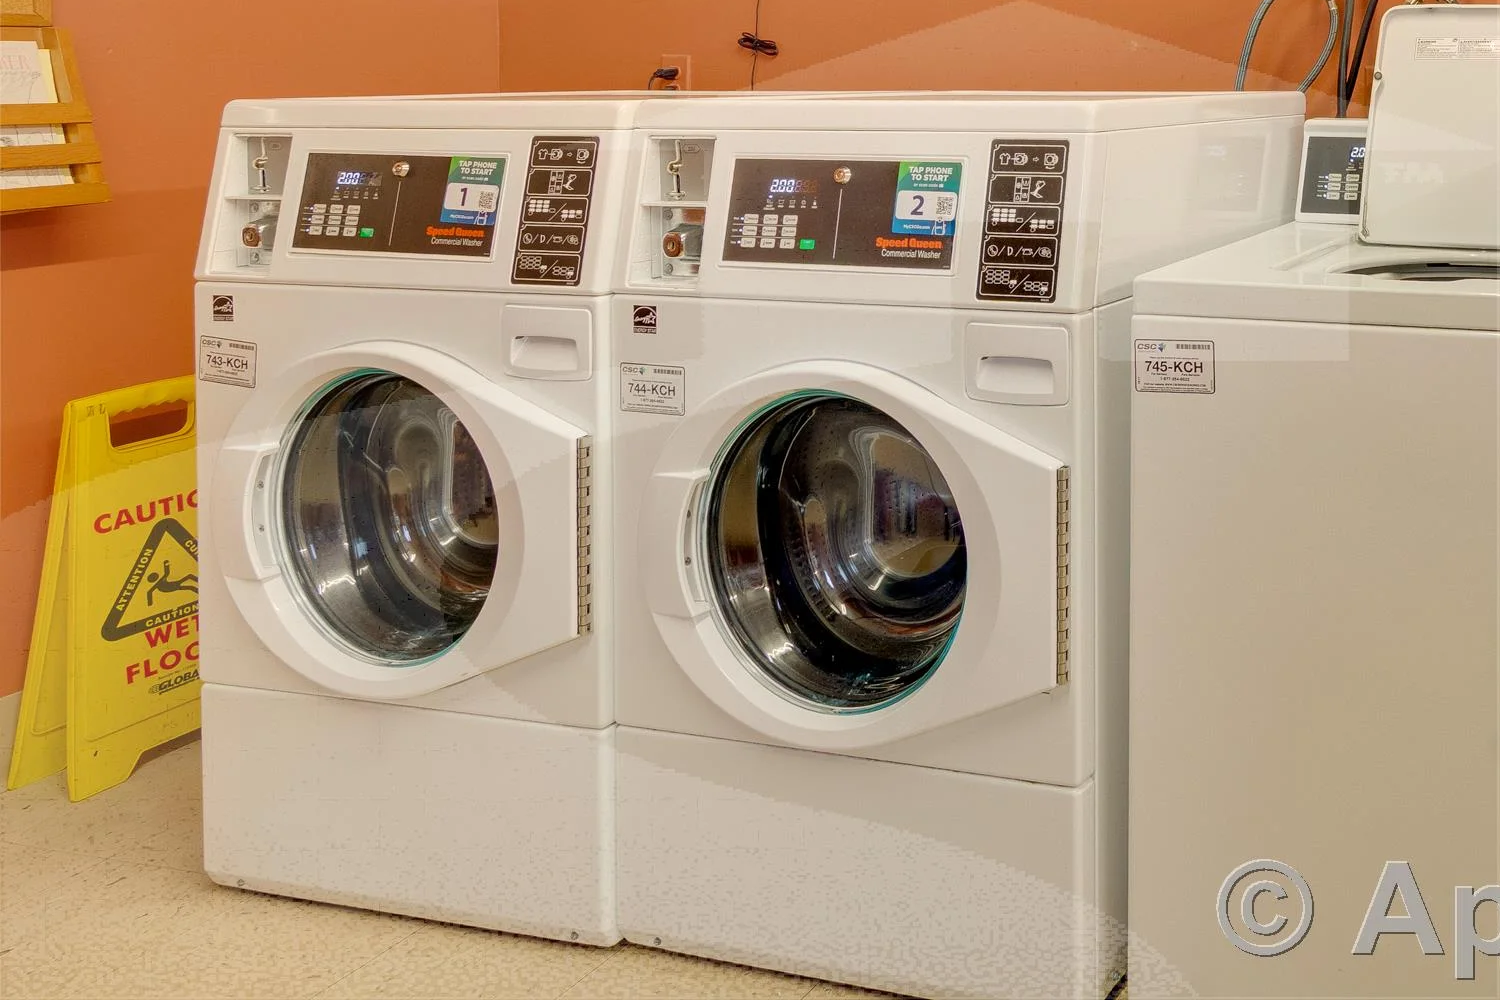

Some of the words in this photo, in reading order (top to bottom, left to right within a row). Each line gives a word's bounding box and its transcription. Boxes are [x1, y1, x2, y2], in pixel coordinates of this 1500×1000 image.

[909, 166, 924, 174] TAP
[925, 167, 953, 175] PHONE
[923, 174, 949, 182] START
[460, 187, 468, 207] 1
[910, 195, 925, 216] 2
[430, 236, 461, 245] Commercial
[462, 238, 483, 247] Washer
[876, 237, 908, 249] Speed
[909, 238, 943, 249] Queen
[881, 248, 917, 258] Commercial
[918, 250, 941, 259] Washer
[206, 354, 248, 370] 743-KCH
[1145, 360, 1203, 373] 745-KCH
[628, 382, 676, 396] 744-KCH
[93, 488, 199, 535] CAUTIO
[116, 548, 153, 612] ATTENTION
[145, 615, 200, 648] WET
[126, 642, 200, 685] FLOO
